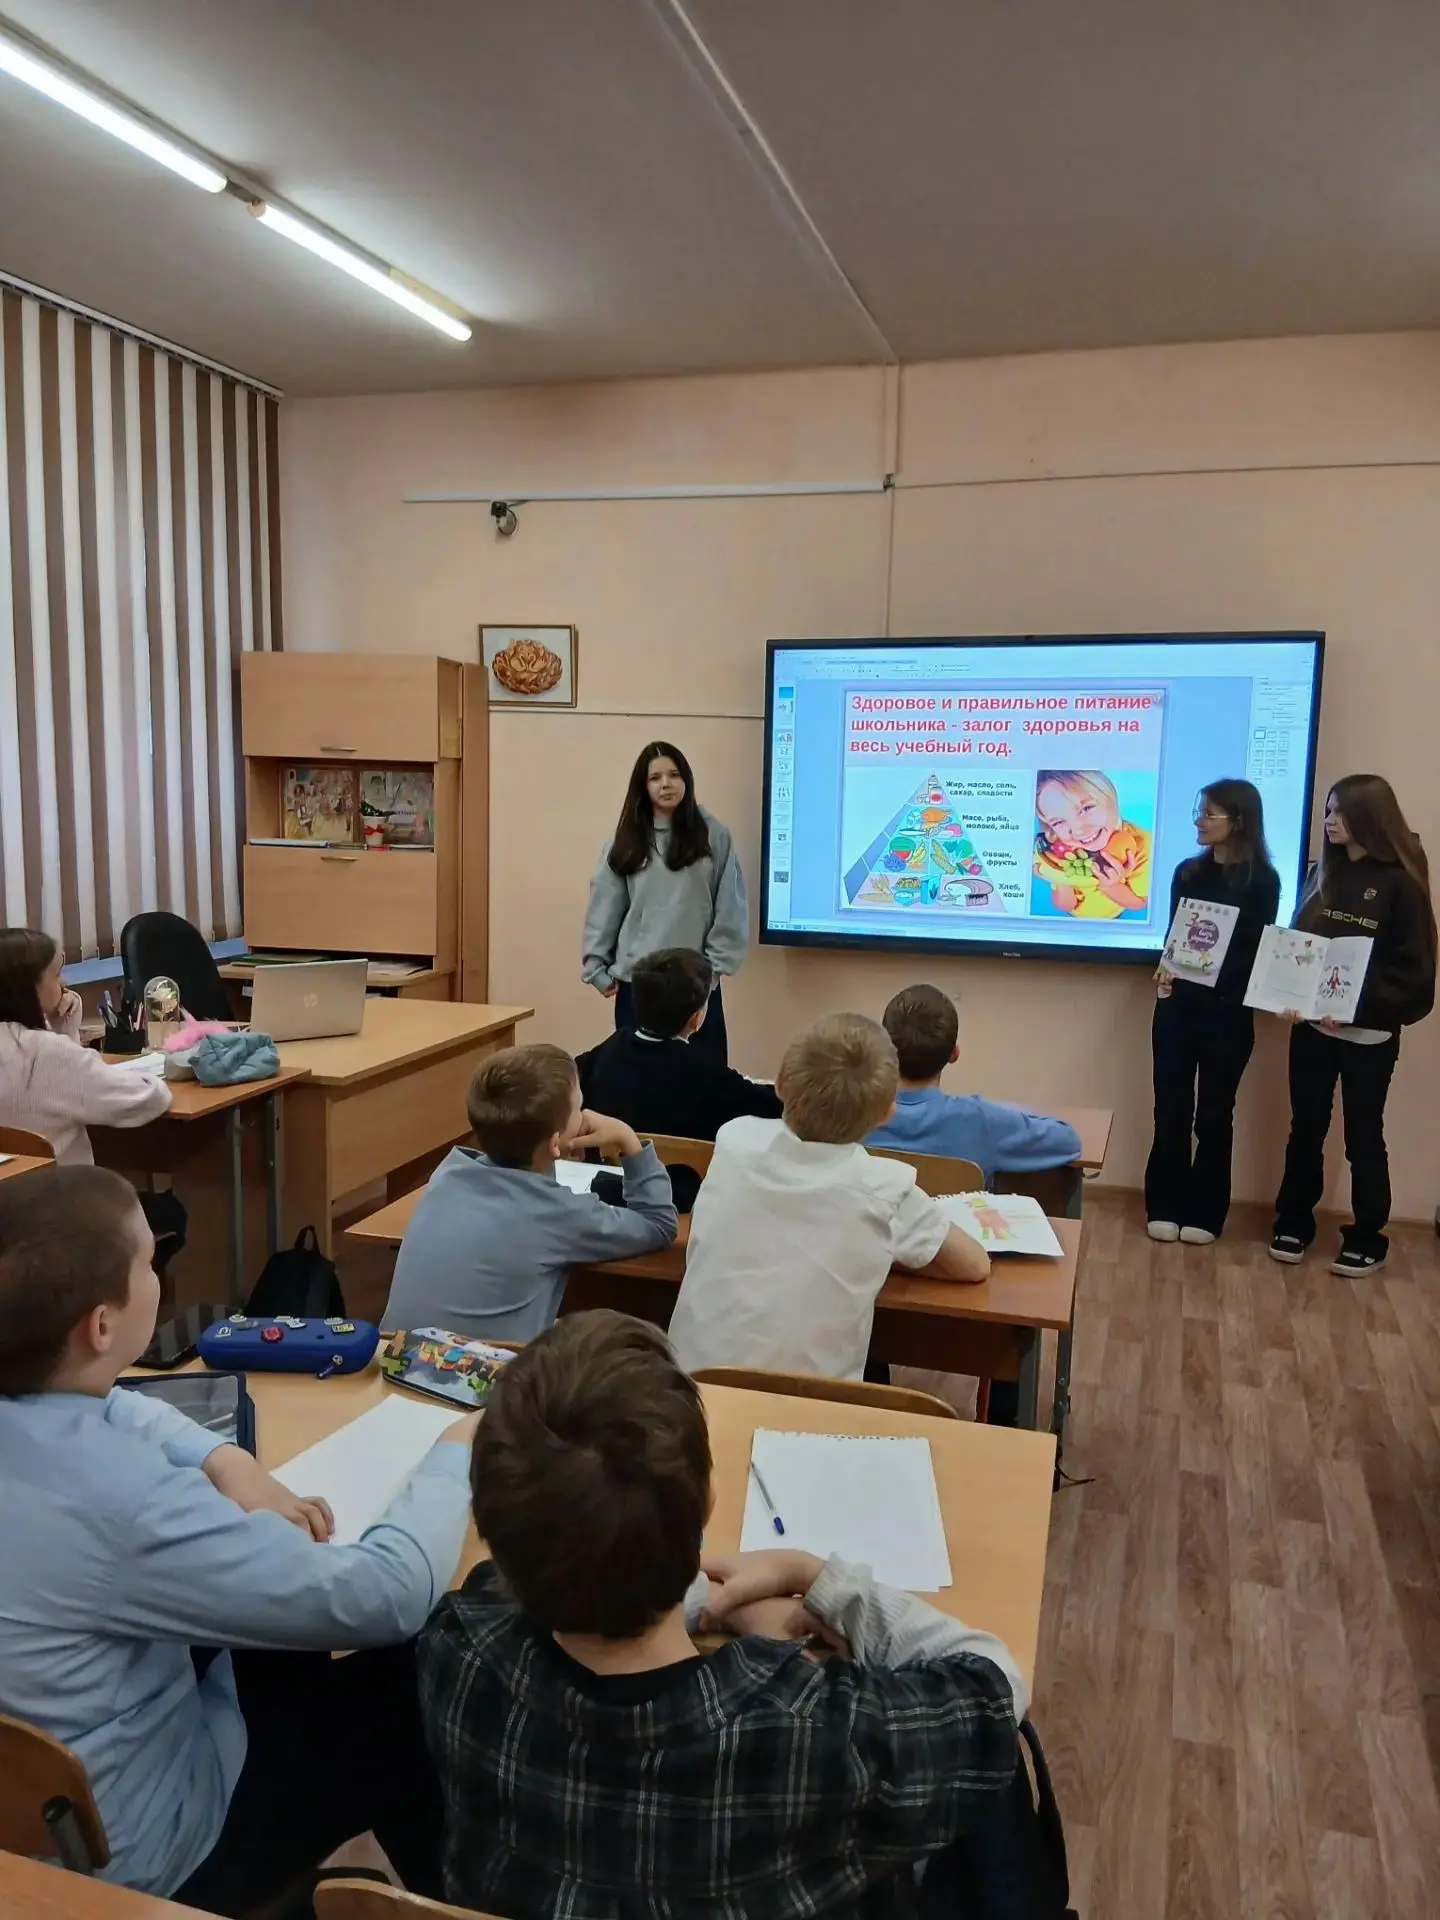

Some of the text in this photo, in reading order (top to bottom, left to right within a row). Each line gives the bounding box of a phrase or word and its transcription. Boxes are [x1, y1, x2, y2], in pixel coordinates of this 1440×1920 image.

[851, 696, 1152, 712] Здоровое и правильное питание
[851, 719, 946, 731] школьника
[962, 719, 1012, 732] залог
[1022, 719, 1111, 735] здоровья
[1117, 720, 1140, 732] на
[850, 738, 1012, 757] весь учебный год.
[945, 780, 965, 789] Жир,
[986, 815, 1010, 823] рыба,
[966, 823, 998, 831] молоко,
[982, 850, 1012, 859] Овощи,
[986, 859, 1018, 867] фрукты
[998, 883, 1021, 891] Хлеб,
